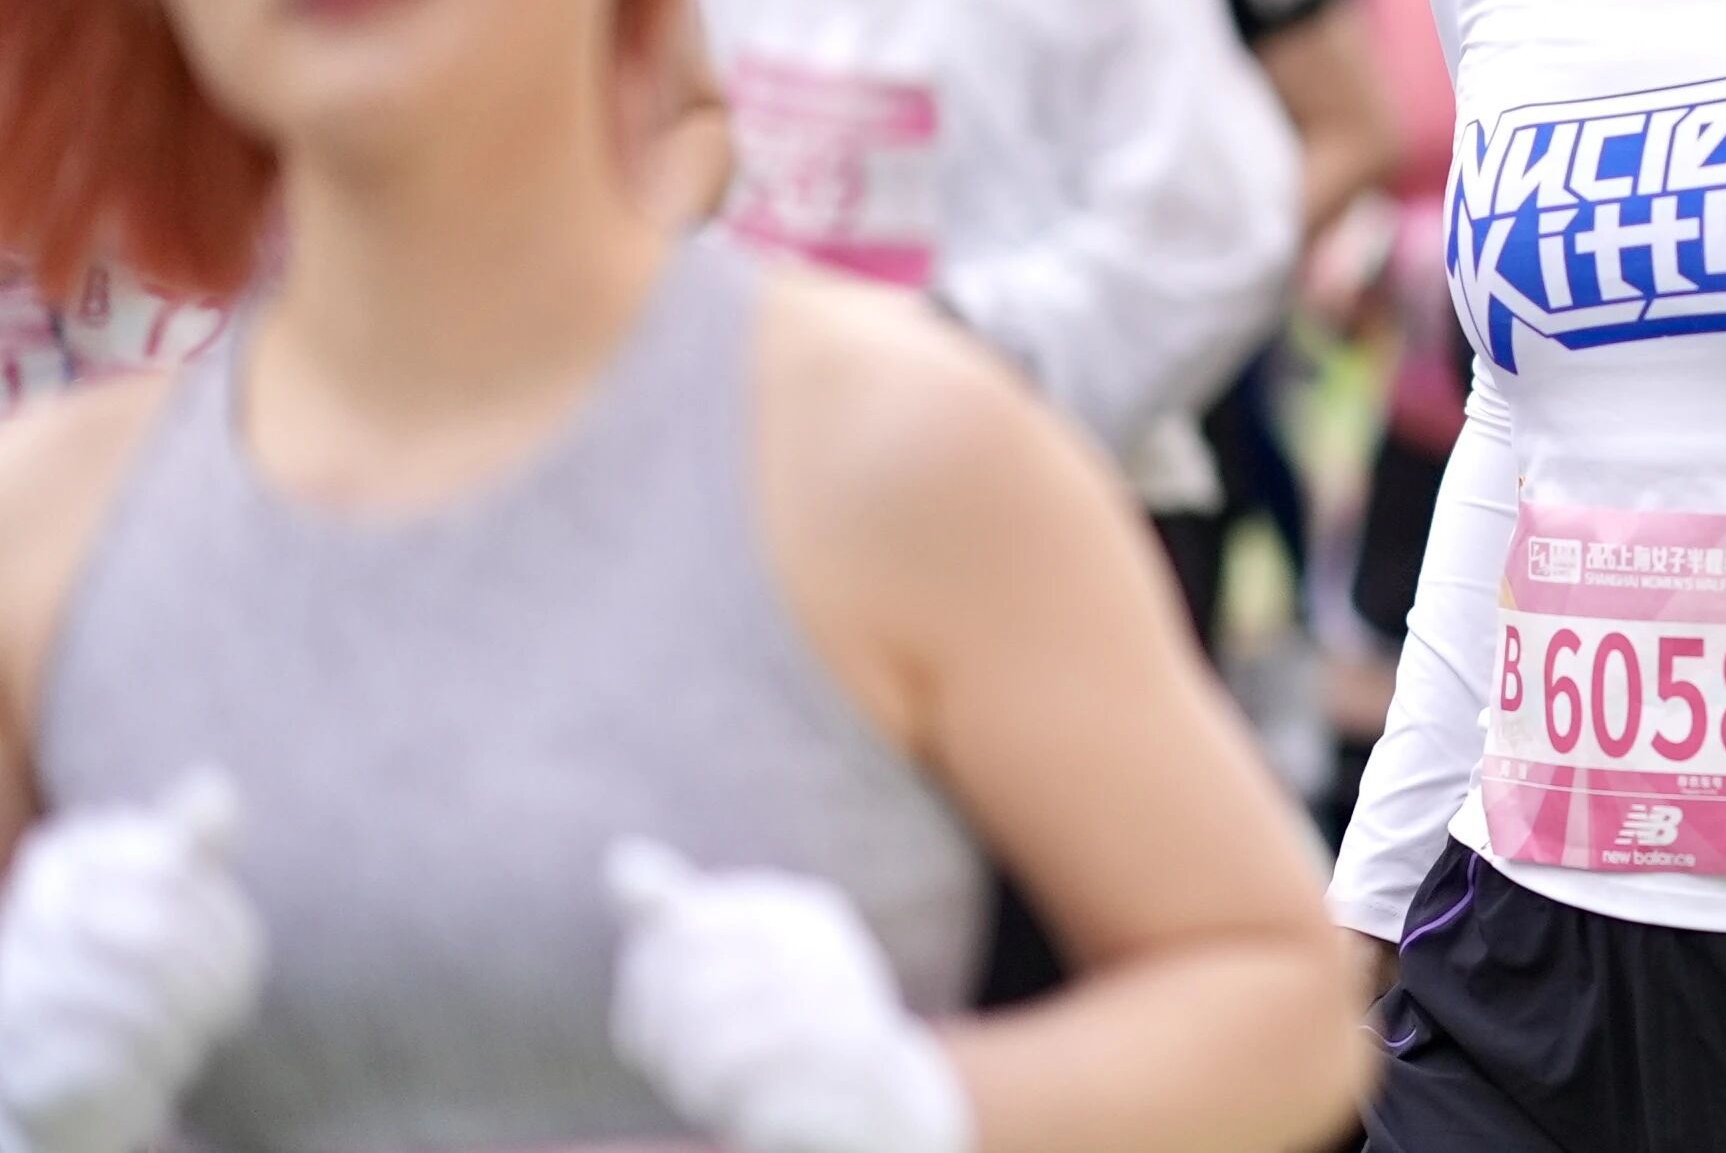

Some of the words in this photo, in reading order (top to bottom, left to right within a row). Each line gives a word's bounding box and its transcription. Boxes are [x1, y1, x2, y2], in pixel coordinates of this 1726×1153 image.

[1501, 625, 1523, 712] B
[1602, 850, 1631, 864] new
[1633, 849, 1697, 867] balance
